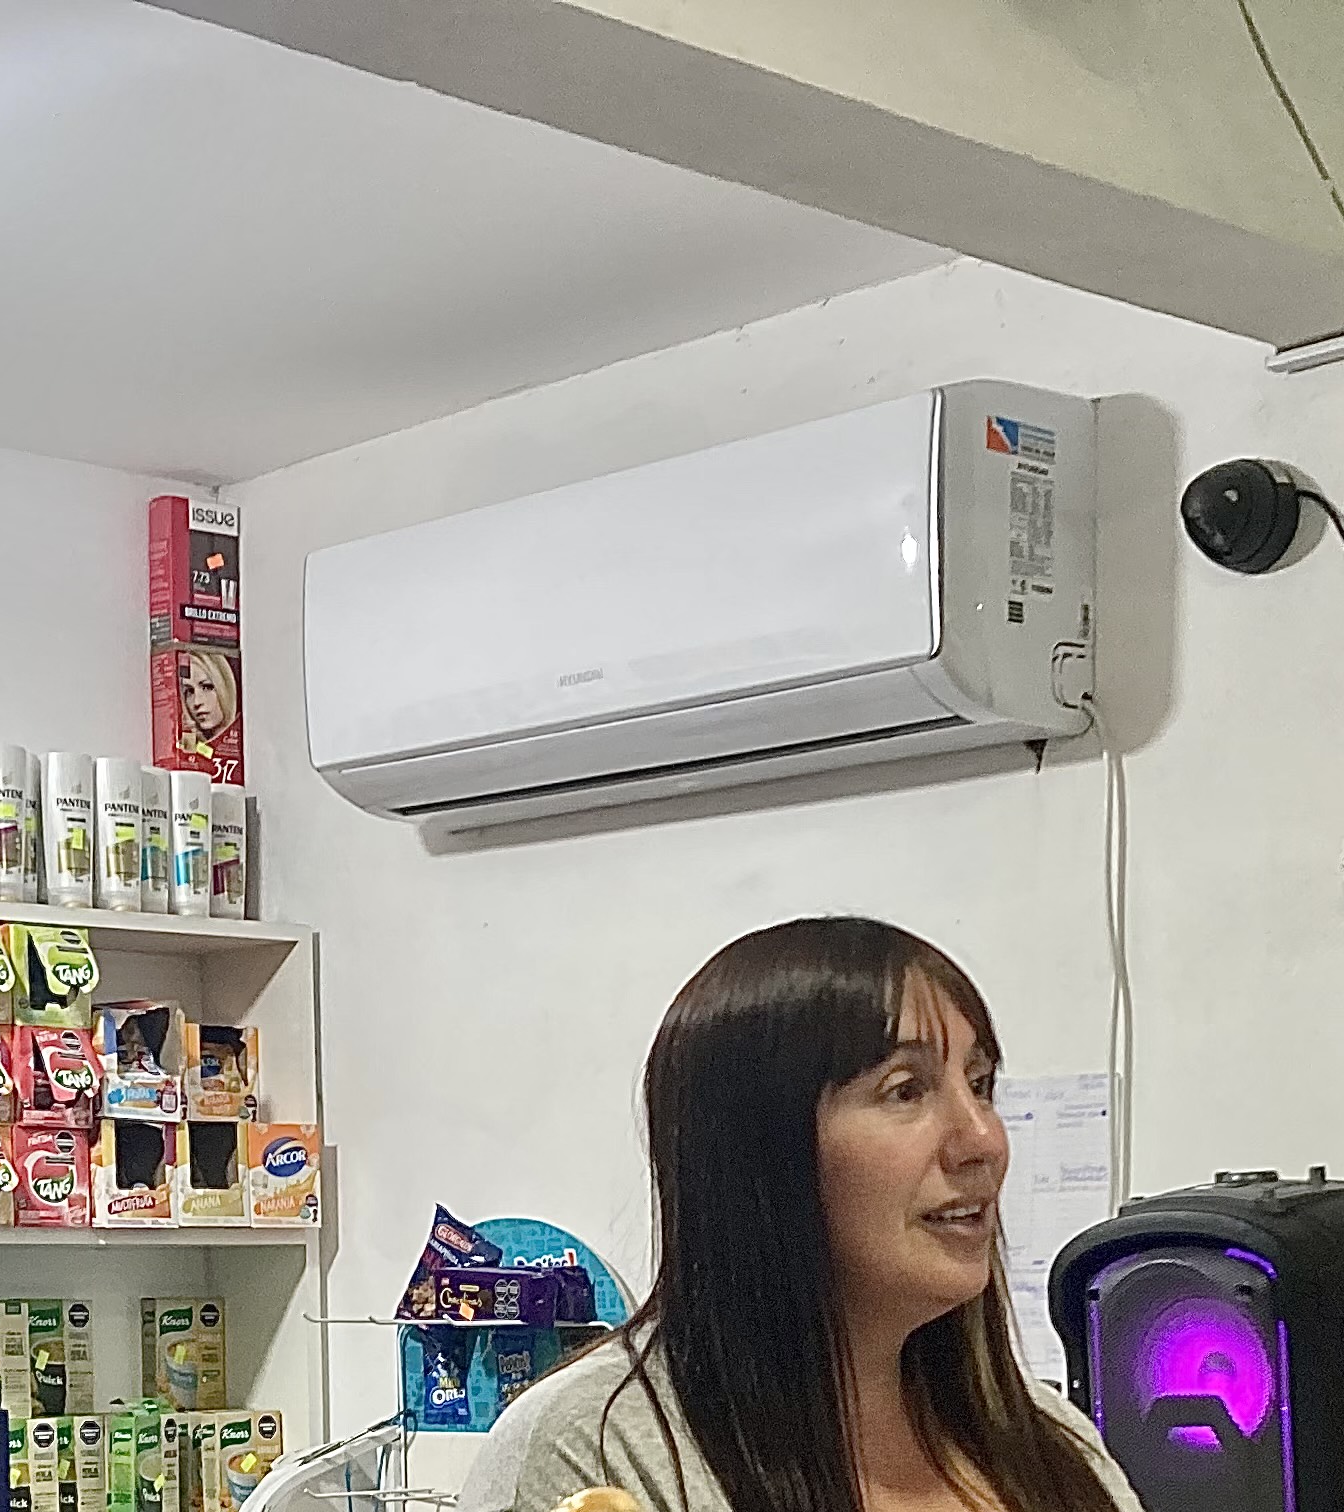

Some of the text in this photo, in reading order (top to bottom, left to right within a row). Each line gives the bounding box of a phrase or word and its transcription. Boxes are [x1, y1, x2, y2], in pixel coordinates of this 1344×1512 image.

[142, 807, 168, 820] ANTENE
[55, 965, 93, 986] TANG
[57, 1073, 94, 1091] TANG
[265, 1149, 307, 1169] ARCOR
[34, 1180, 72, 1203] TANG
[29, 1315, 57, 1327] Knorr
[161, 1315, 191, 1327] Knorr
[221, 1427, 250, 1440] Knorr
[10, 1499, 28, 1509] ick
